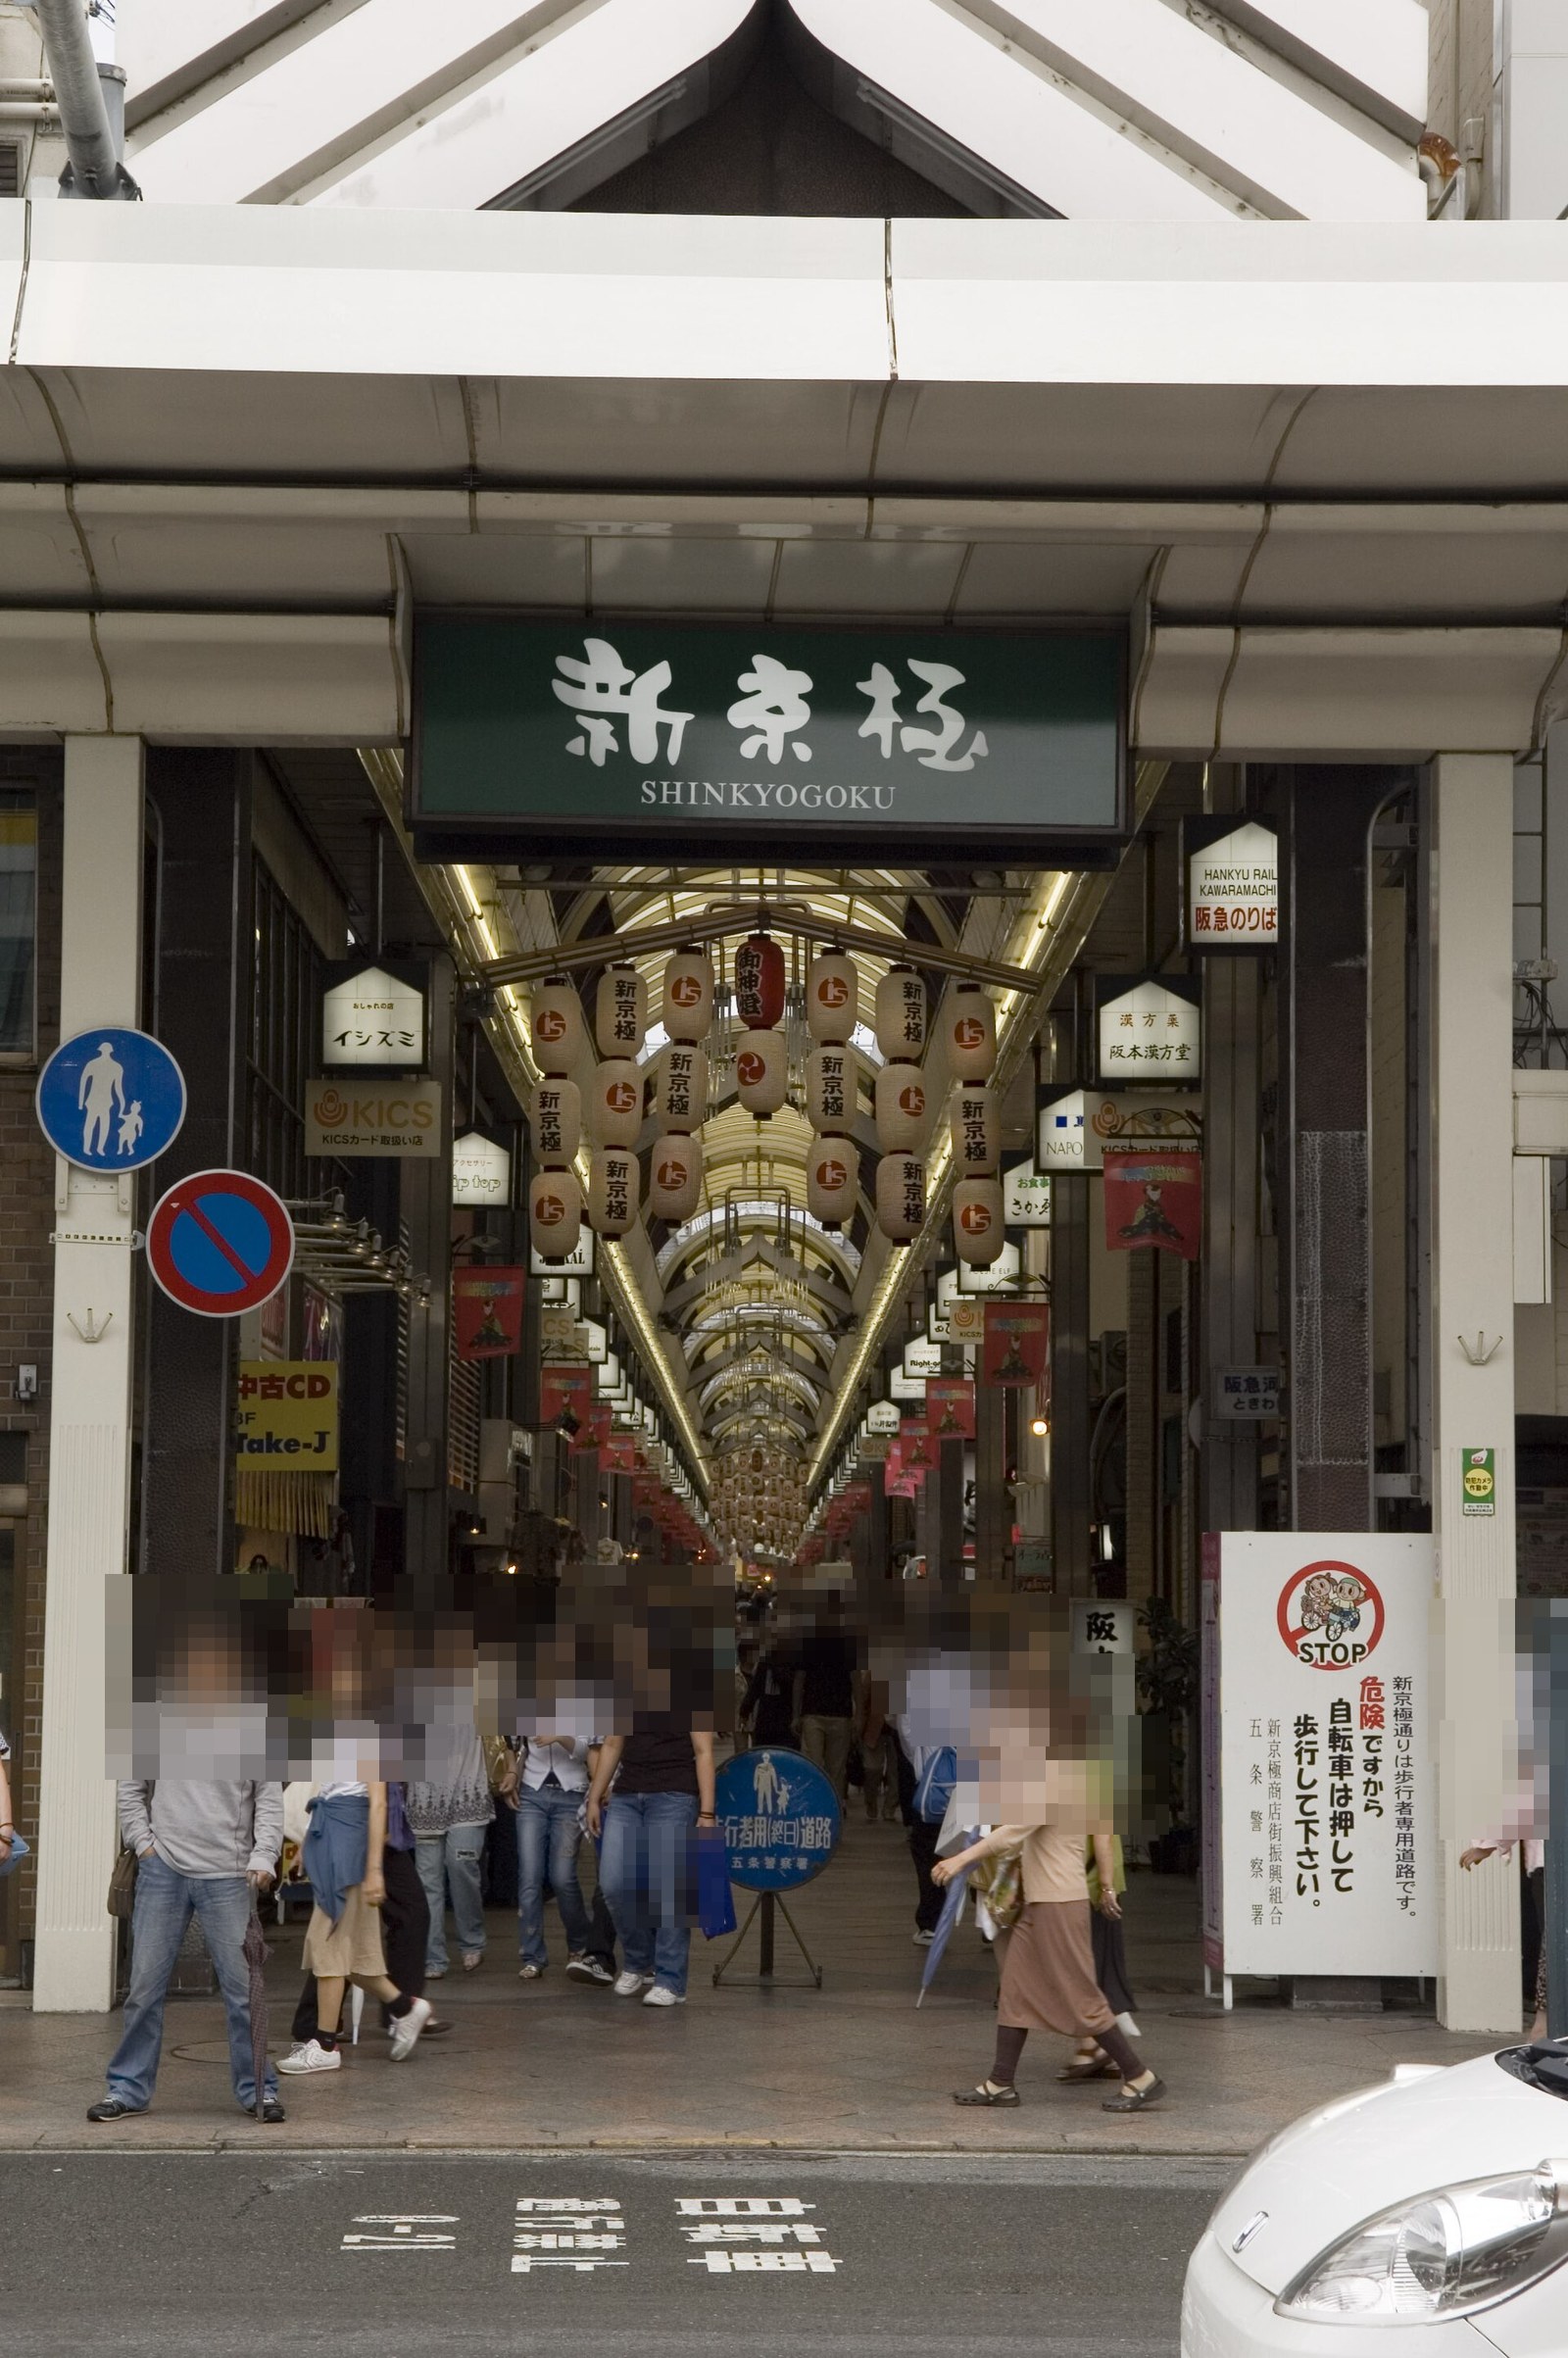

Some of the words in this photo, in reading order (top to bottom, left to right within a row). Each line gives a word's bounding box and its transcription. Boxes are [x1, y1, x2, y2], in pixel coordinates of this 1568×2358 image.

[552, 637, 989, 772] 新京極
[640, 780, 897, 811] SHINKYOGOKU
[1200, 884, 1277, 897] KAWARAMACHI
[1204, 868, 1250, 881] HANKYU
[1195, 907, 1278, 932] 阪急のりば
[332, 1030, 416, 1048] イシズミ
[614, 979, 637, 1041] 新京極
[903, 980, 922, 1043] 新京極
[1119, 1012, 1180, 1028] 漢方薬
[666, 1052, 692, 1115] 新京極
[1108, 1044, 1192, 1061] 阪本漢方堂
[353, 1100, 434, 1129] KICS
[821, 1056, 844, 1117] 新京極
[321, 1134, 423, 1147] KICSカード取扱い店
[538, 1090, 562, 1153] 新京極
[962, 1100, 988, 1162] 新京極
[605, 1159, 628, 1220] 新京極
[903, 1161, 923, 1224] 新京極
[1299, 1643, 1367, 1665] STOP
[1359, 1676, 1385, 1819] 危険ですから
[1249, 1718, 1264, 1926] 五条警察署
[1267, 1718, 1283, 1926] 新京極商店街振興組合
[1293, 1714, 1320, 1908] 歩行して下さい。
[1328, 1698, 1355, 1893] 自転車は押して
[1392, 1676, 1416, 1918] 新京極通りは歩行者専用道路です。
